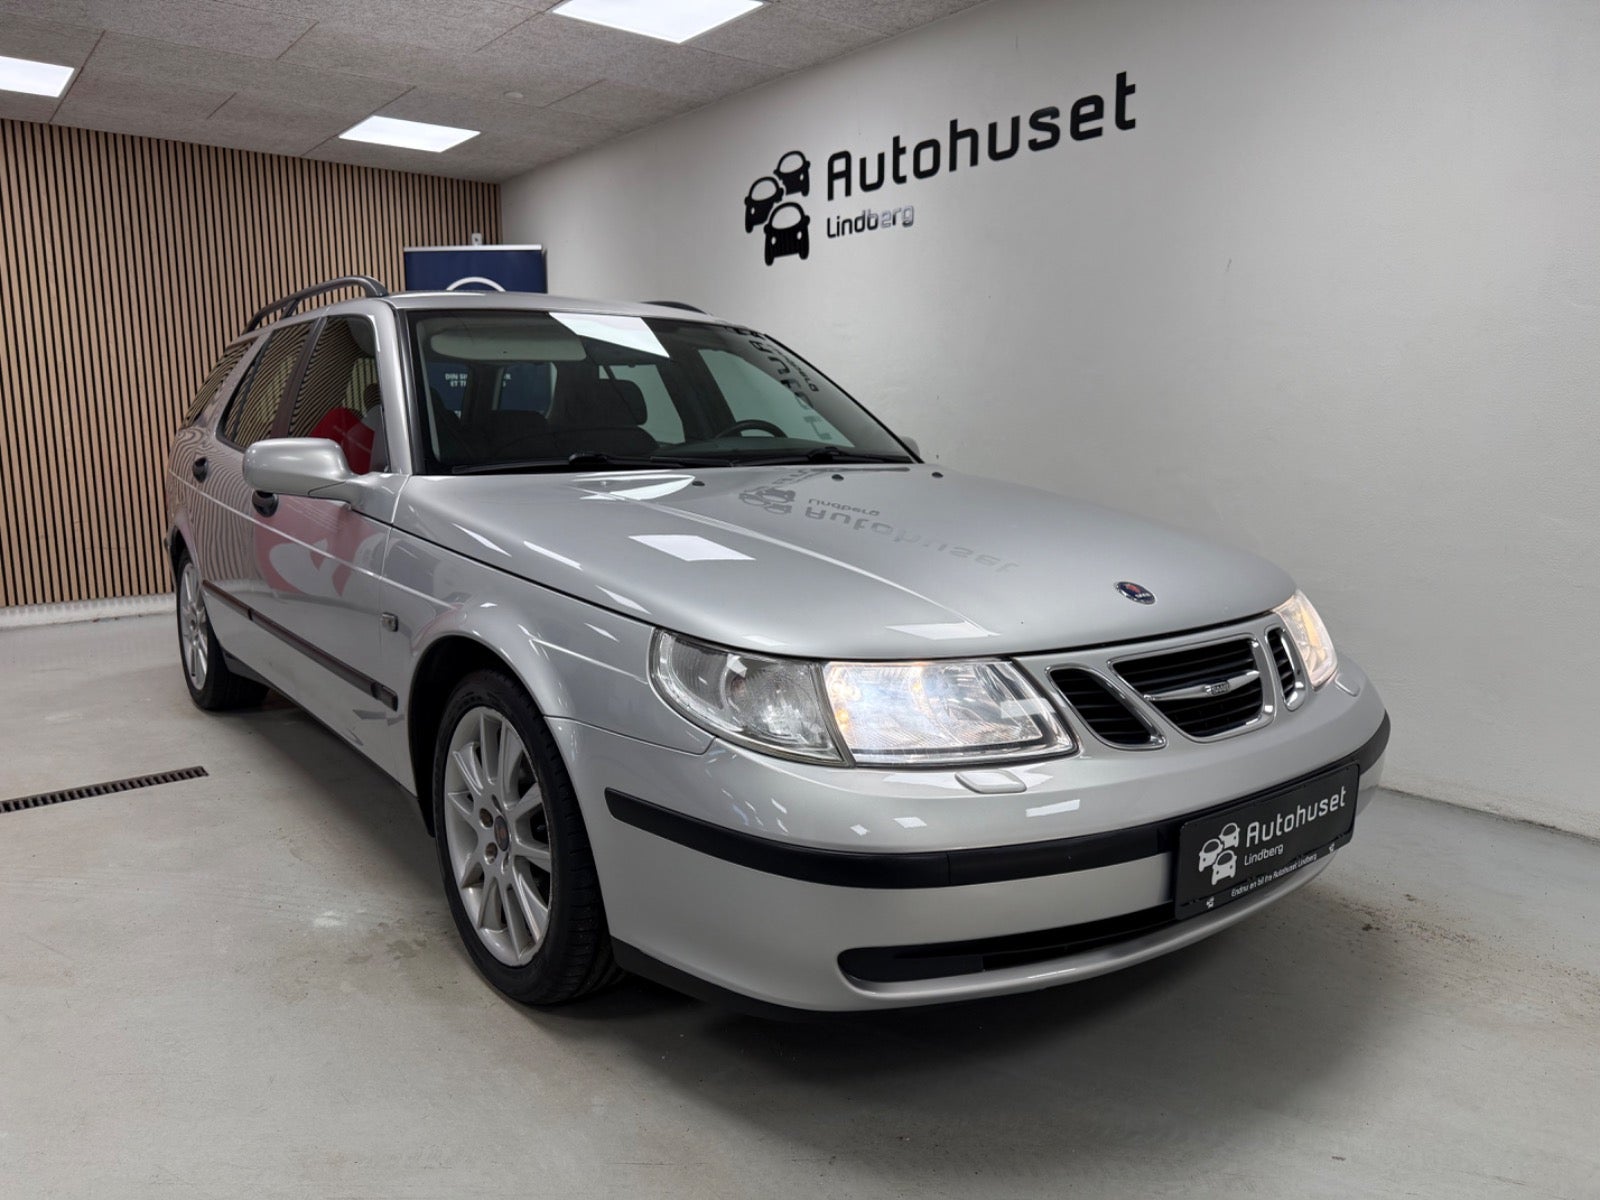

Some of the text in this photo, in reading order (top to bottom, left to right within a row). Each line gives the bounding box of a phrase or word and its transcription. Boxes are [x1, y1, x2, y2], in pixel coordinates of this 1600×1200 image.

[827, 71, 1136, 201] Autohuset
[827, 205, 915, 239] Lindberg
[1245, 786, 1346, 848] Autohuset
[1244, 844, 1284, 866] Lindberg
